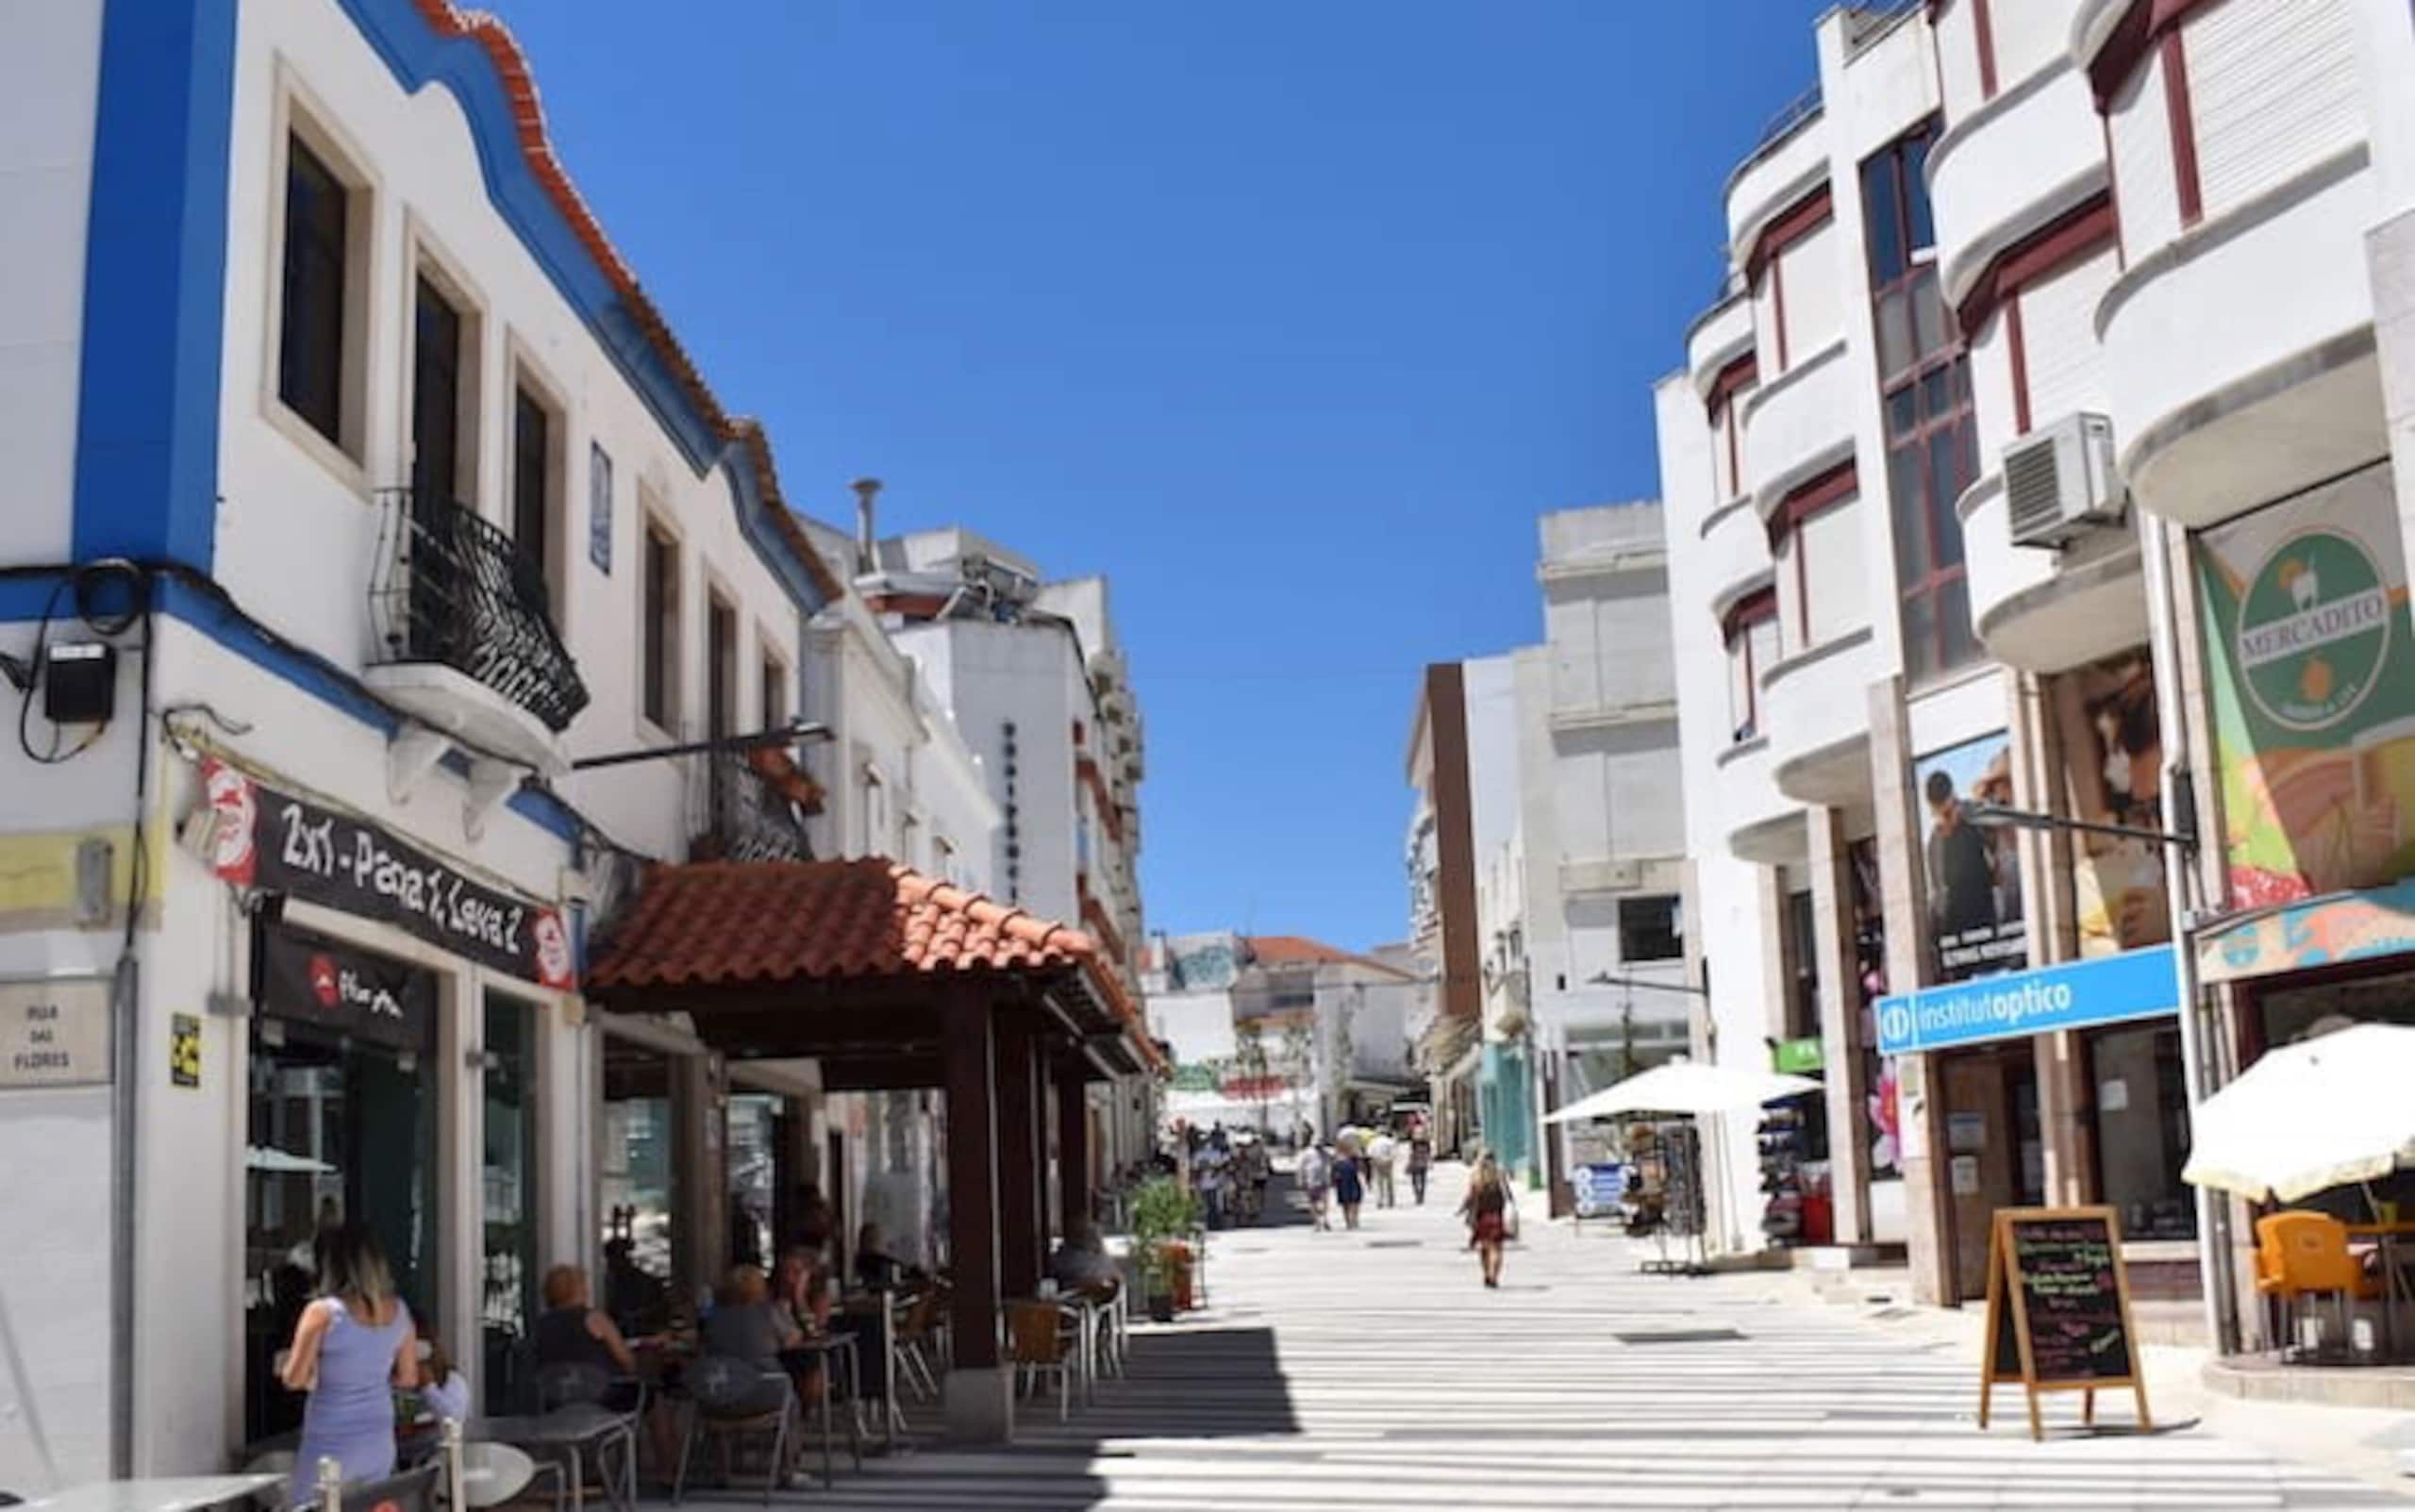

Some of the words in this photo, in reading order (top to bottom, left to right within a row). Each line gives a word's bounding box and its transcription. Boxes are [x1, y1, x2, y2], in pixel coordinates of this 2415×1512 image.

[2242, 594, 2383, 658] MERCADITO
[26, 1005, 58, 1022] RUA
[14, 1051, 70, 1071] FLORES
